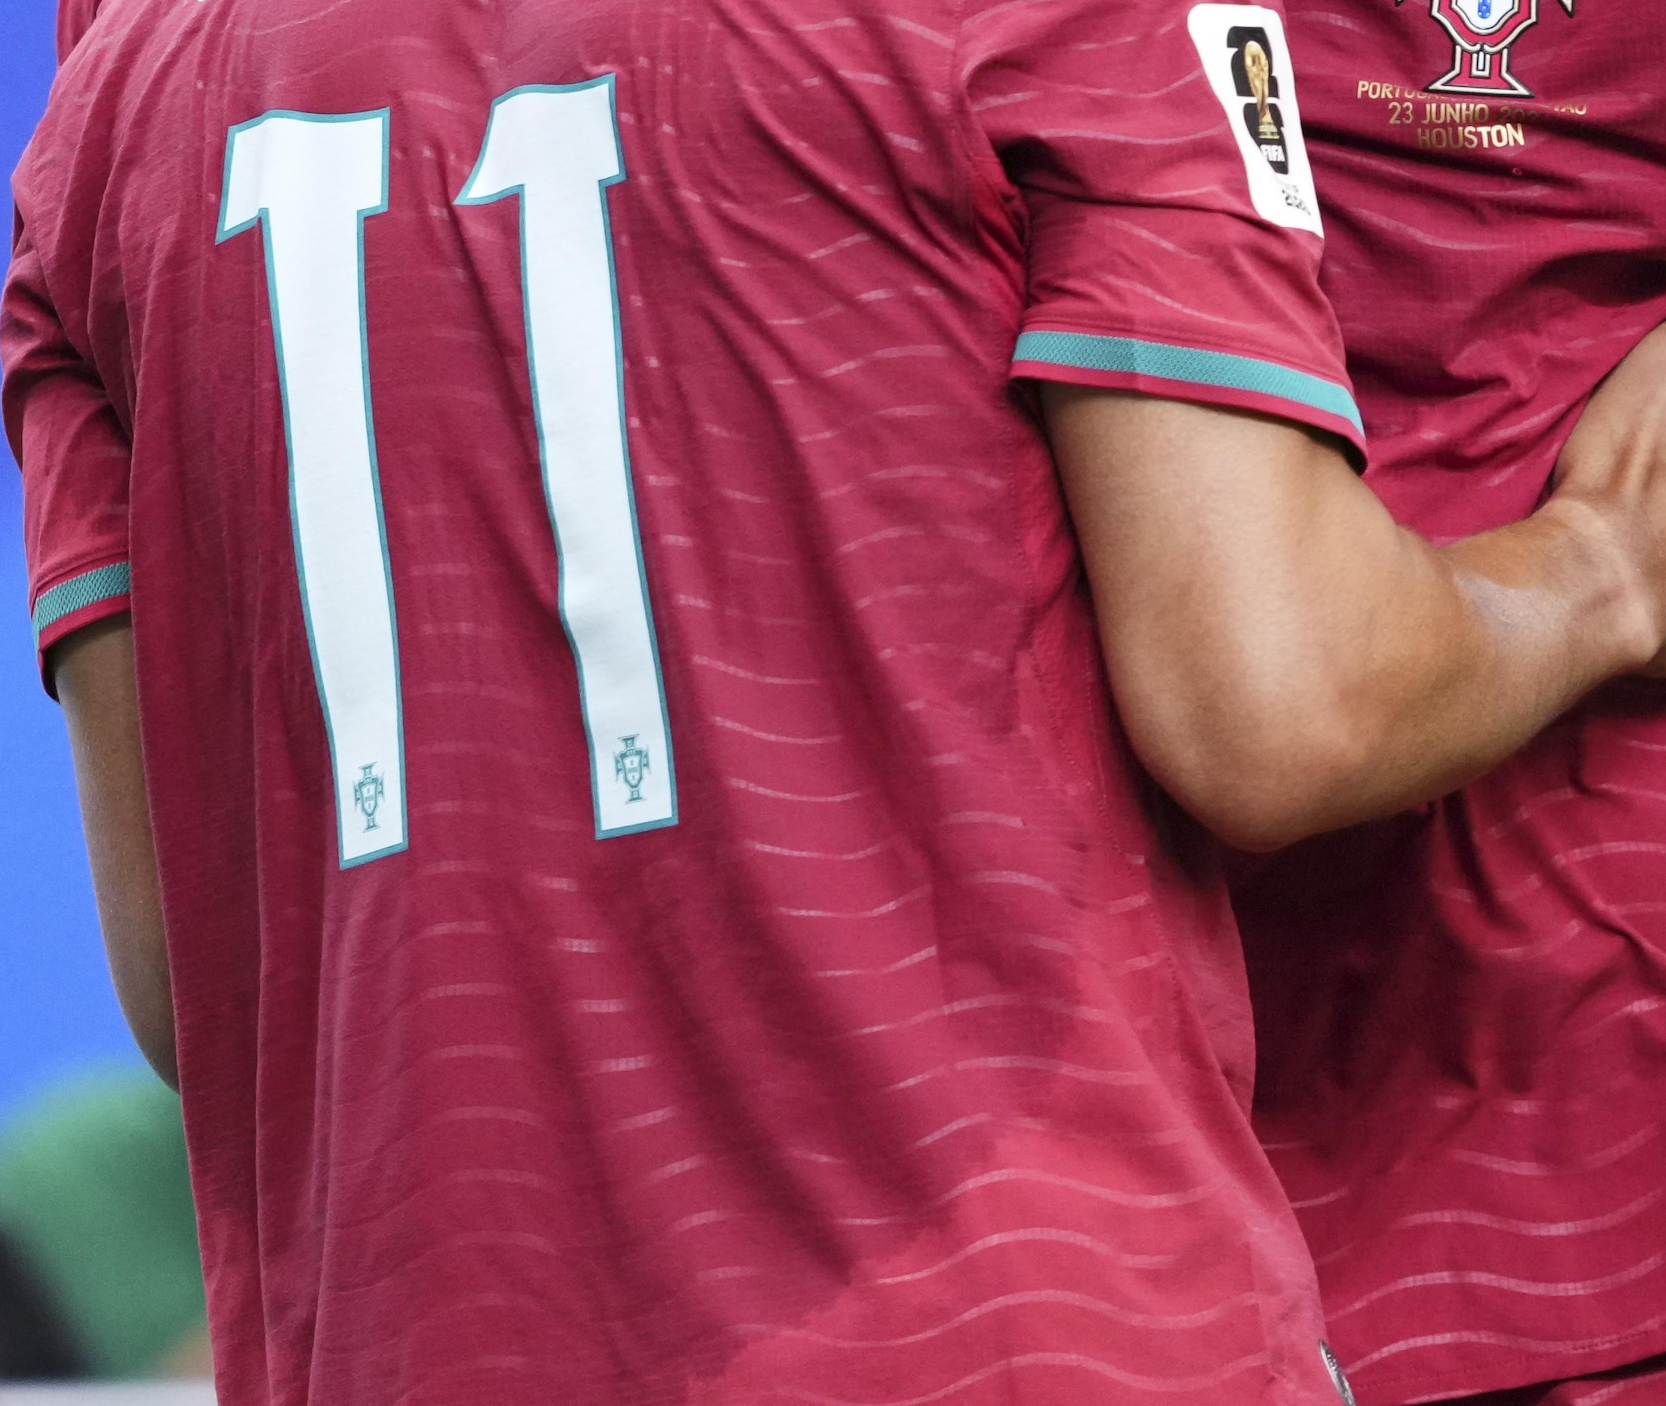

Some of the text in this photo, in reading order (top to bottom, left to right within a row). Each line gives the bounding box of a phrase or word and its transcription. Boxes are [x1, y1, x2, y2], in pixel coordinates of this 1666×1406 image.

[1388, 101, 1414, 125] 23
[1421, 102, 1490, 125] JUNHO
[1417, 122, 1526, 150] HOUSTON
[215, 72, 680, 871] 11
